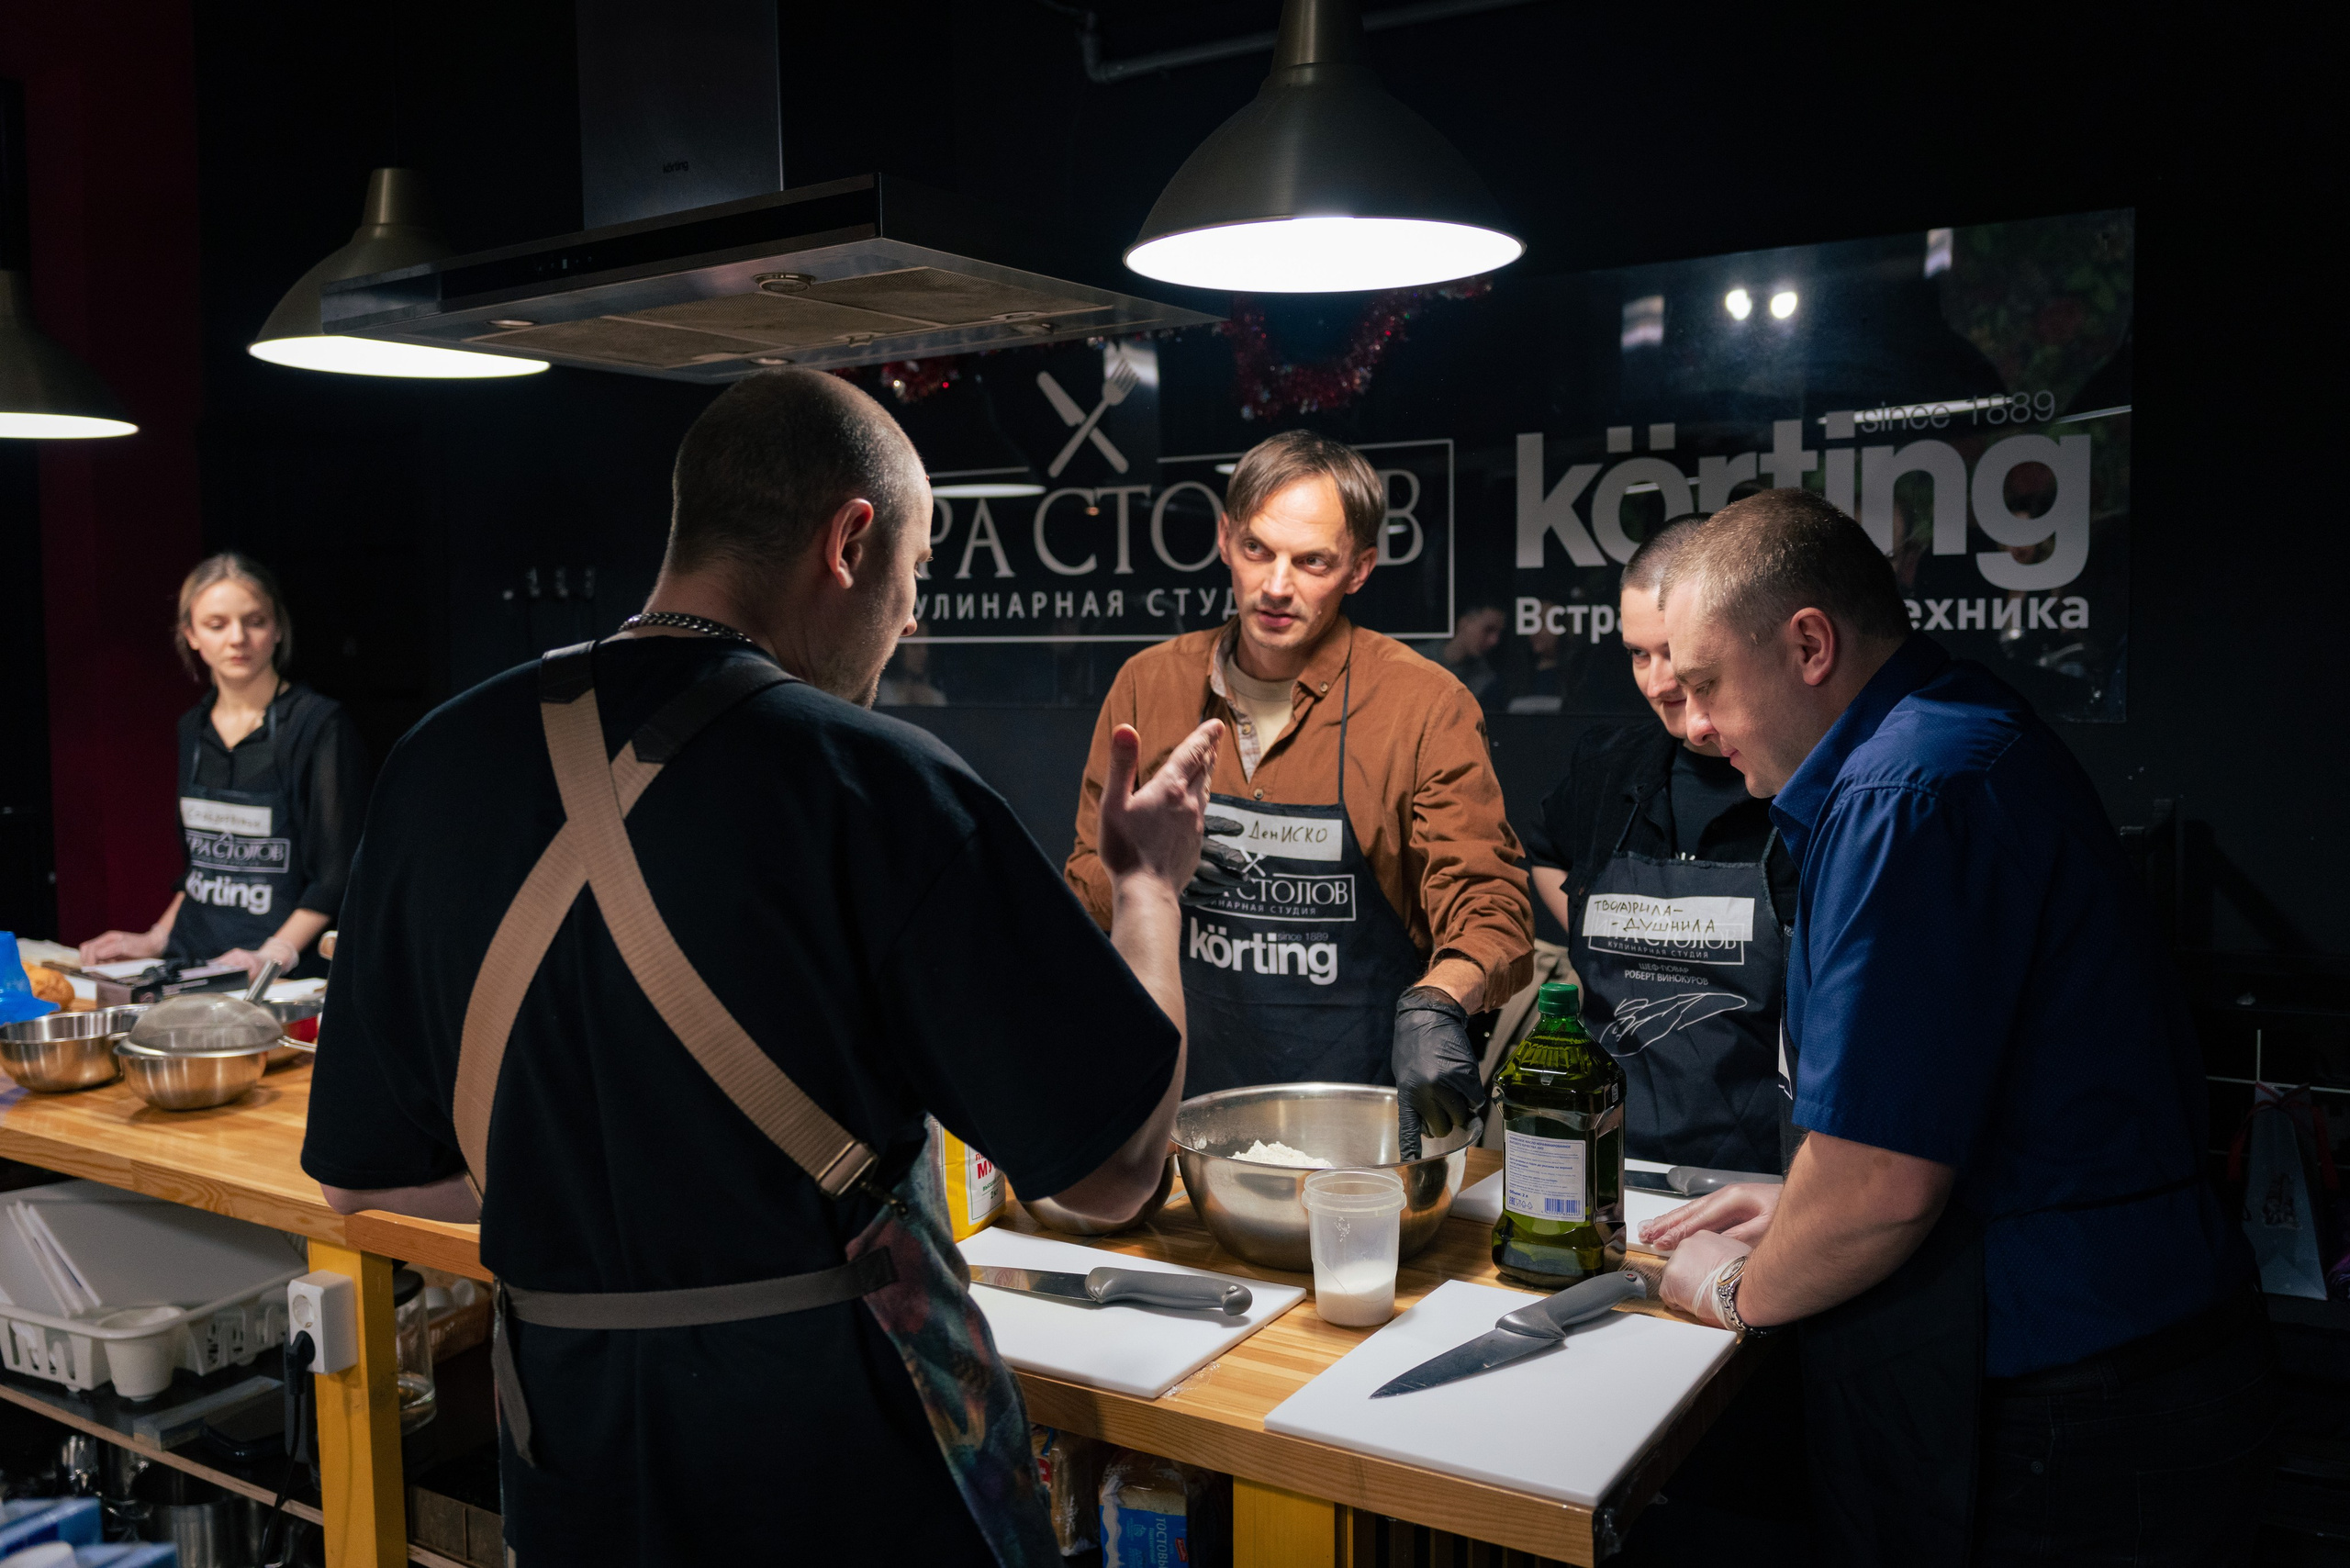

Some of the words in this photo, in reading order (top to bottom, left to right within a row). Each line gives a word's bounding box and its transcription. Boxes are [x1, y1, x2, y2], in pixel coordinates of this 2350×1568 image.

[1861, 400, 1951, 433] since
[1965, 389, 2055, 425] 1889
[1033, 469, 1424, 577] СТОВ
[913, 589, 1125, 621] УЛИНАРНАЯ
[1147, 588, 1240, 622] СТУД
[1516, 596, 1623, 644] Встр
[1901, 595, 2089, 631] ехника
[1211, 900, 1264, 913] ИНАРНАЯ
[1190, 916, 1337, 986] körting
[1277, 932, 1302, 942] since
[1305, 931, 1329, 942] 1889
[1607, 941, 1667, 956] КУЛИНАРНАЯ
[1671, 949, 1709, 958] СТУДИЯ
[1624, 969, 1655, 981] РОБЕРТ
[1657, 973, 1709, 986] ВИНОКУРОВ
[1156, 1518, 1168, 1568] ТОСТОВЫ
